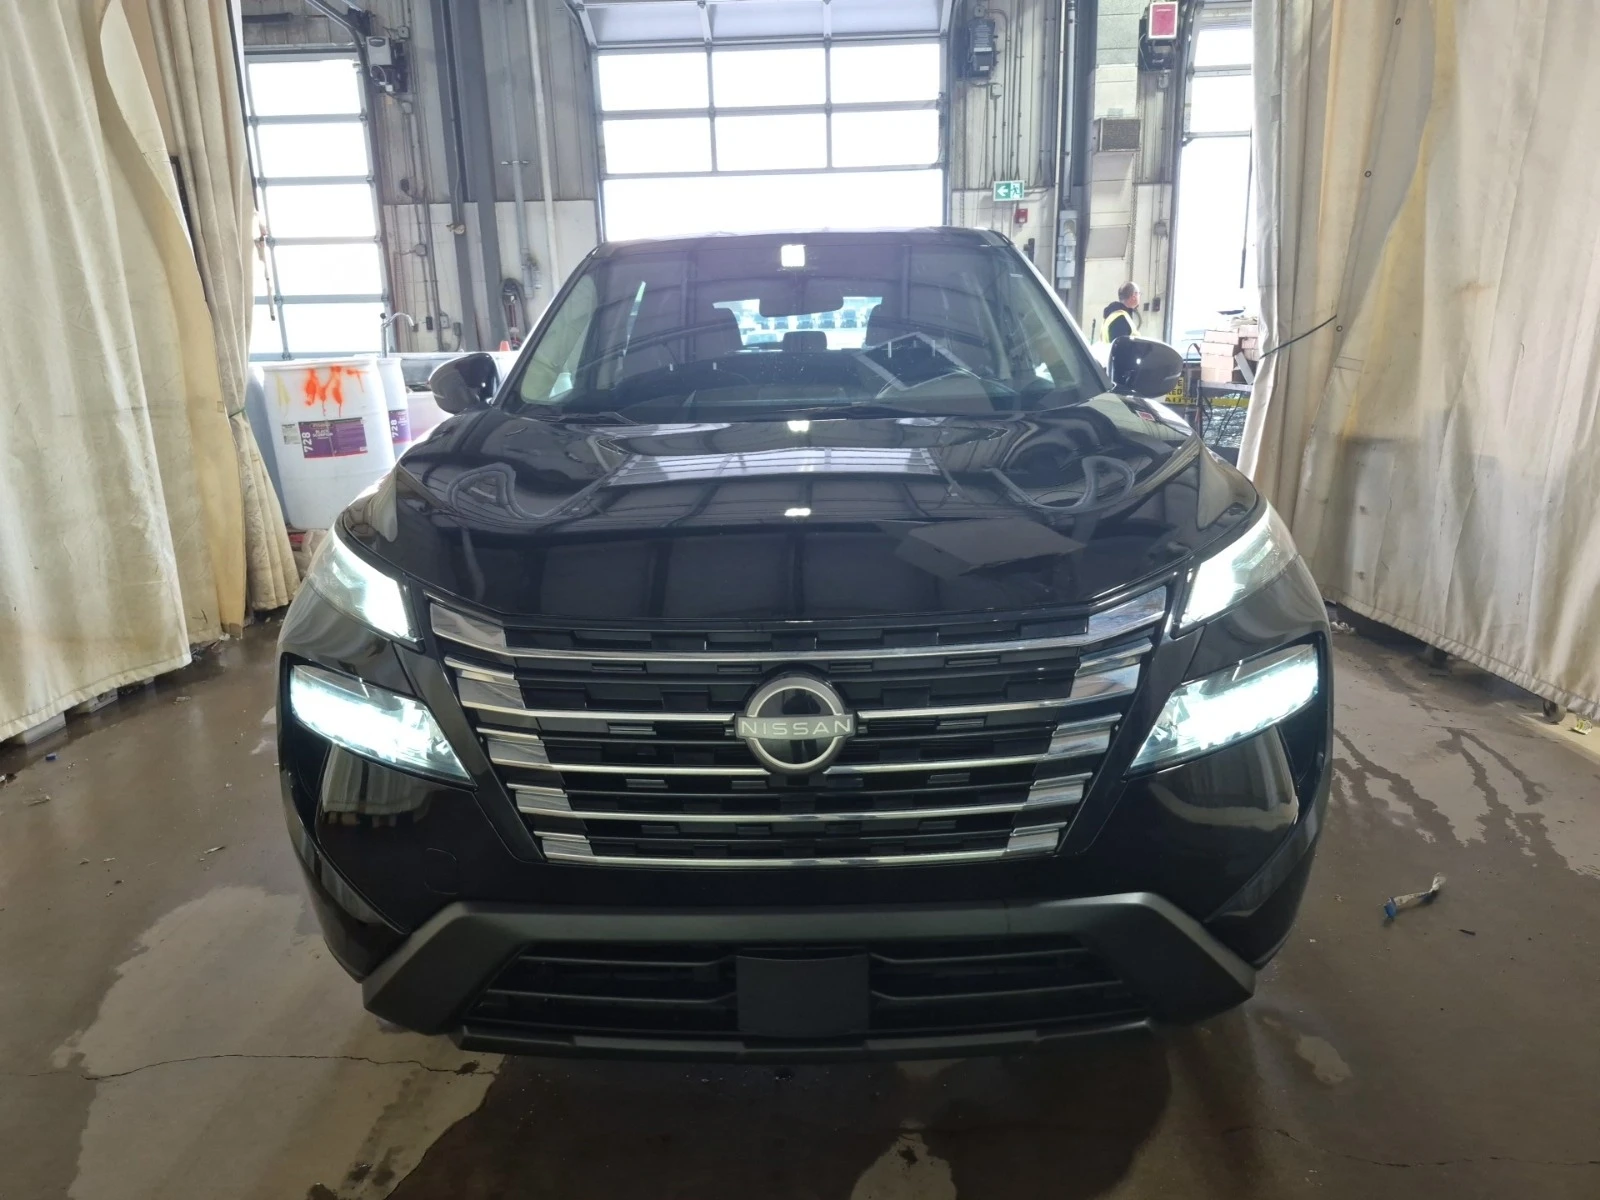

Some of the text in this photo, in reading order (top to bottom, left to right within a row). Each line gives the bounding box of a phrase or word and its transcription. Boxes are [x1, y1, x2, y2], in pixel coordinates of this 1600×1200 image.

[391, 419, 399, 438] 728
[301, 431, 314, 453] 728
[741, 718, 851, 736] NISSAN
